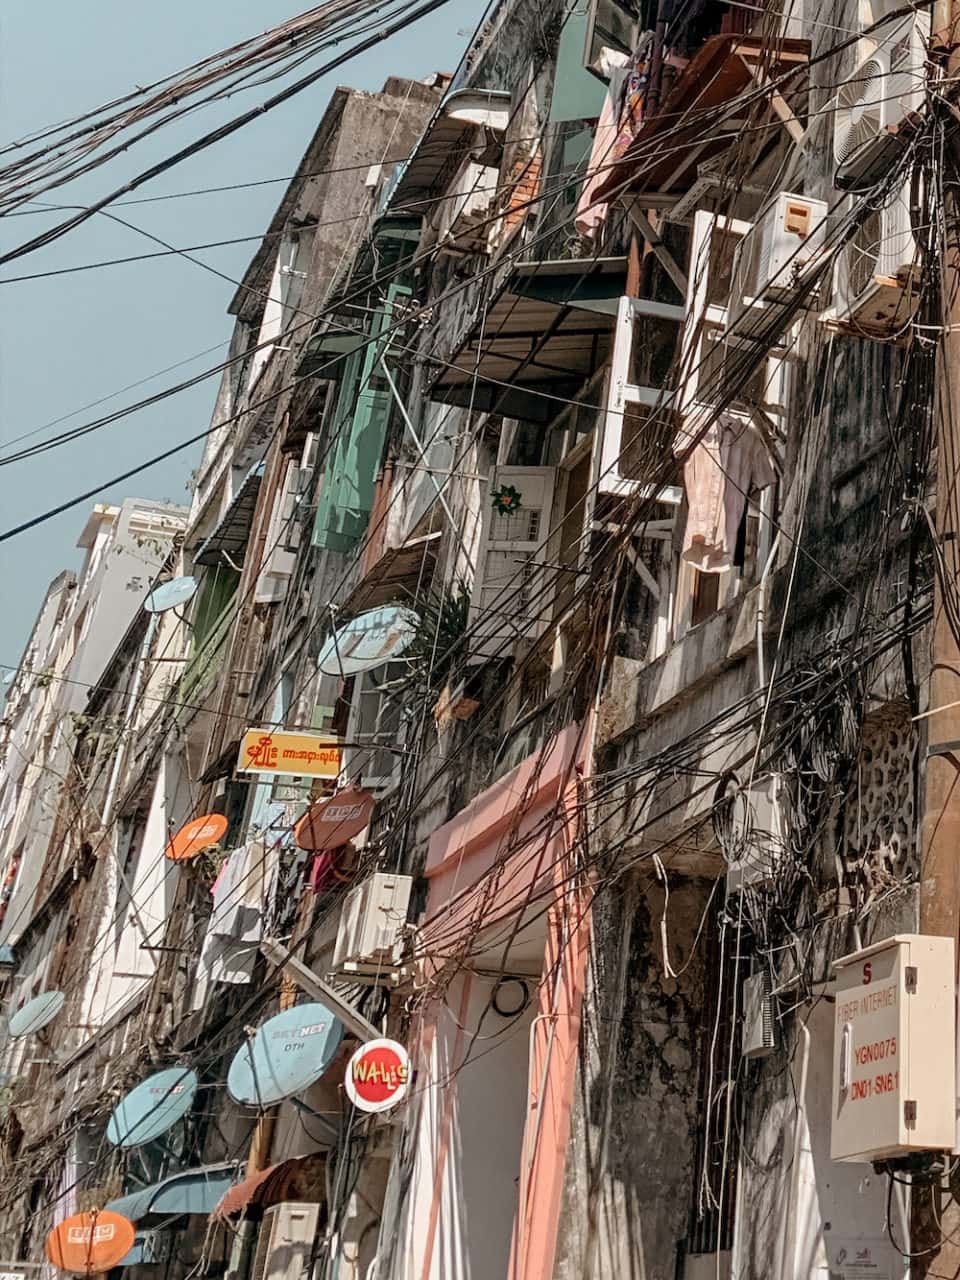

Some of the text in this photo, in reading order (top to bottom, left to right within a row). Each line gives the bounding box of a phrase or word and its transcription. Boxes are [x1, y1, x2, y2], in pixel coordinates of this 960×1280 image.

[862, 962, 872, 985] S
[838, 985, 897, 1024] FIBER INTERNET
[854, 1037, 897, 1066] YGN0075
